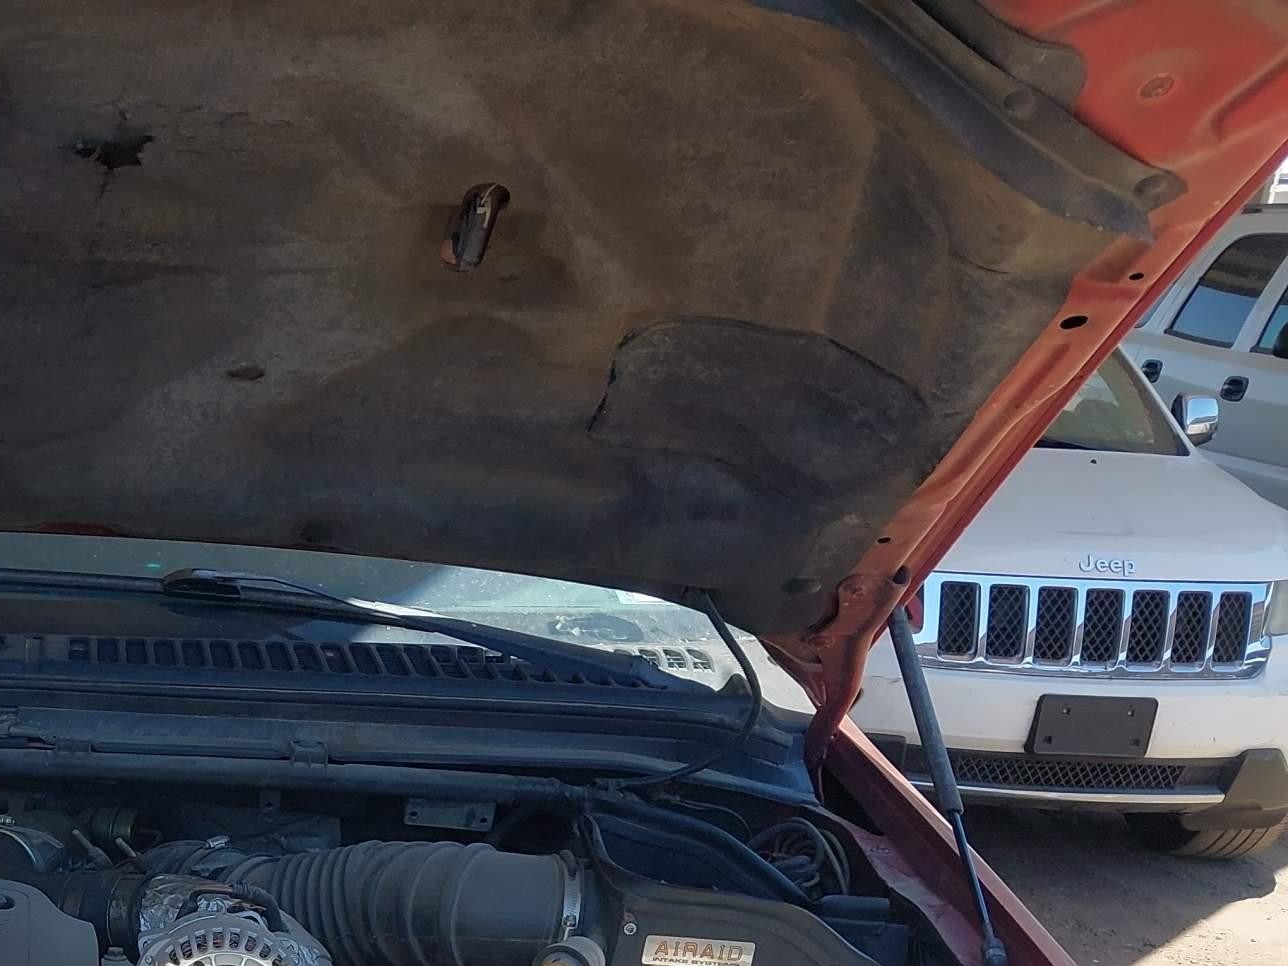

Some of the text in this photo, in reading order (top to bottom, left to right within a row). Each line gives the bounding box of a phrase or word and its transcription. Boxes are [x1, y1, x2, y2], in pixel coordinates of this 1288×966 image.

[1078, 554, 1136, 577] Jeep
[652, 956, 689, 965] INTAKE
[654, 940, 743, 961] AIRAID
